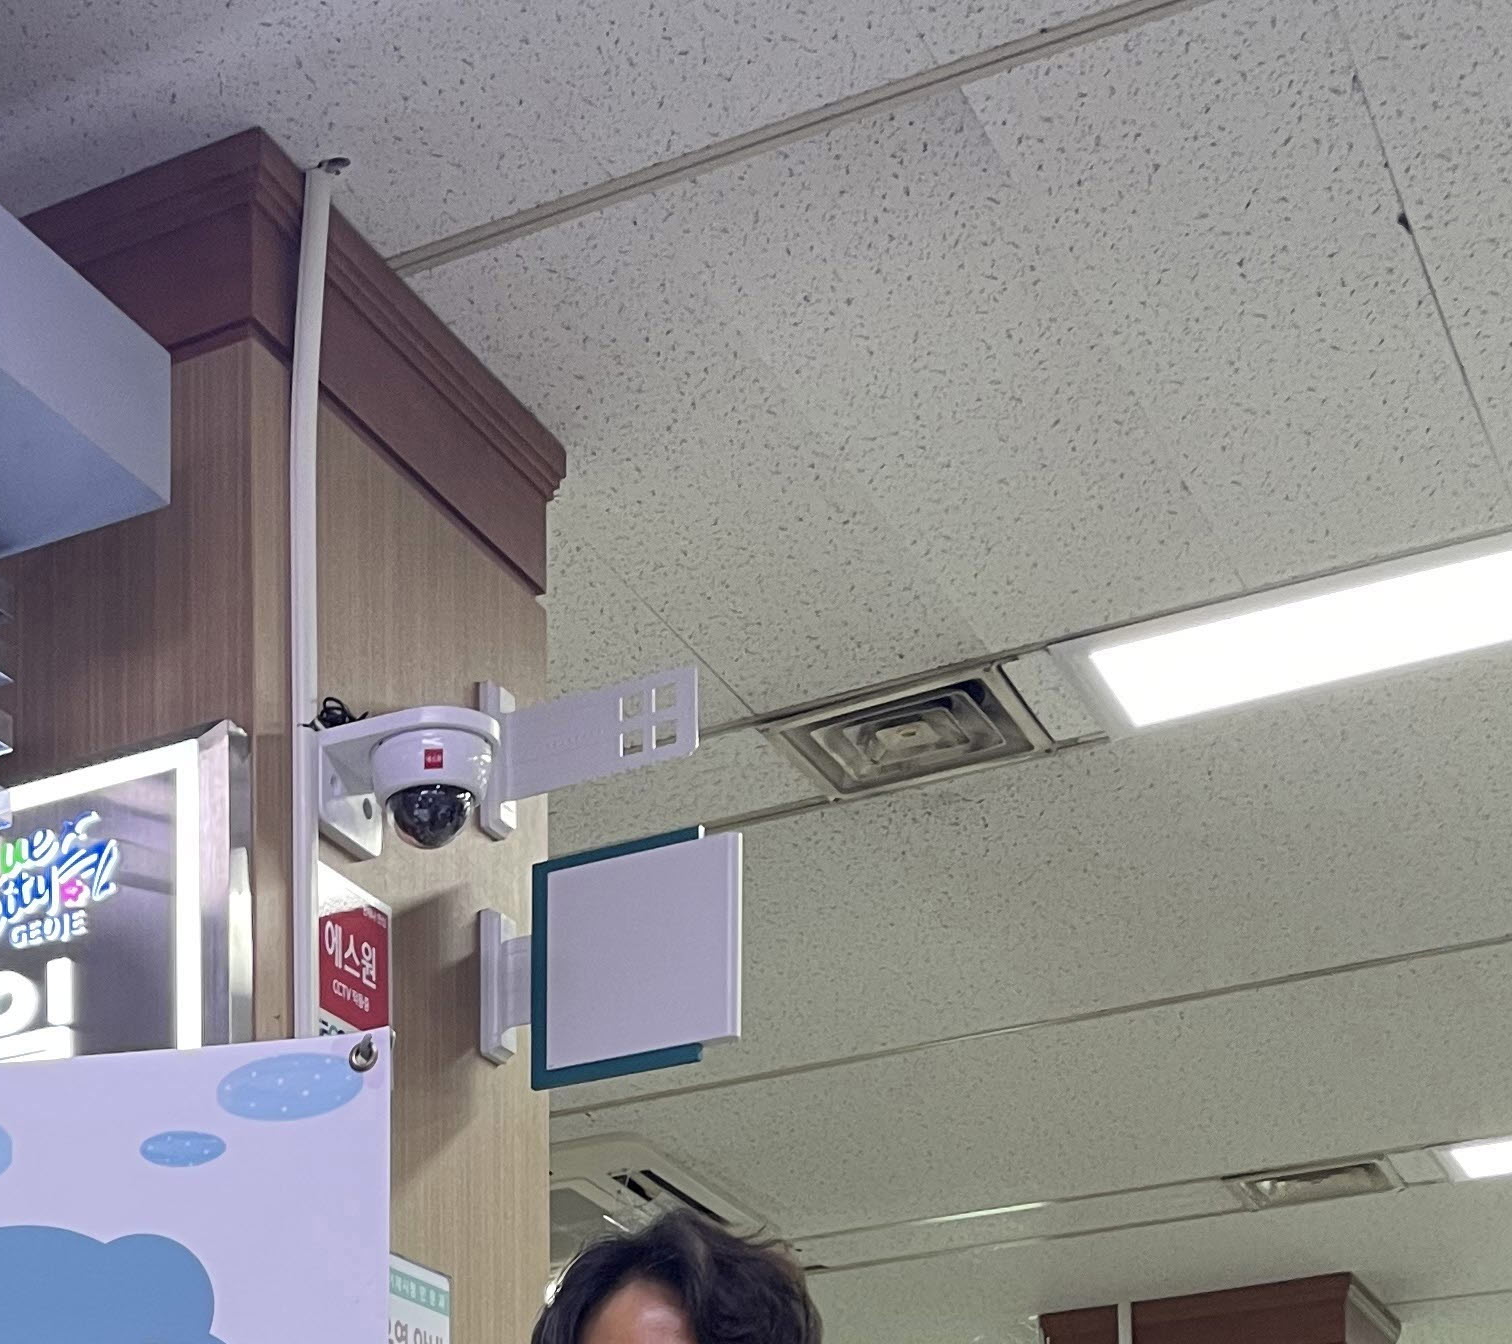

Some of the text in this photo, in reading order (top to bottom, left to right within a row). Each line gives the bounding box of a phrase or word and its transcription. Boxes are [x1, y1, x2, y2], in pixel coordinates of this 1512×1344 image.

[10, 910, 88, 948] GEOJE
[324, 920, 377, 989] 에스원
[332, 979, 352, 1001] CCTV
